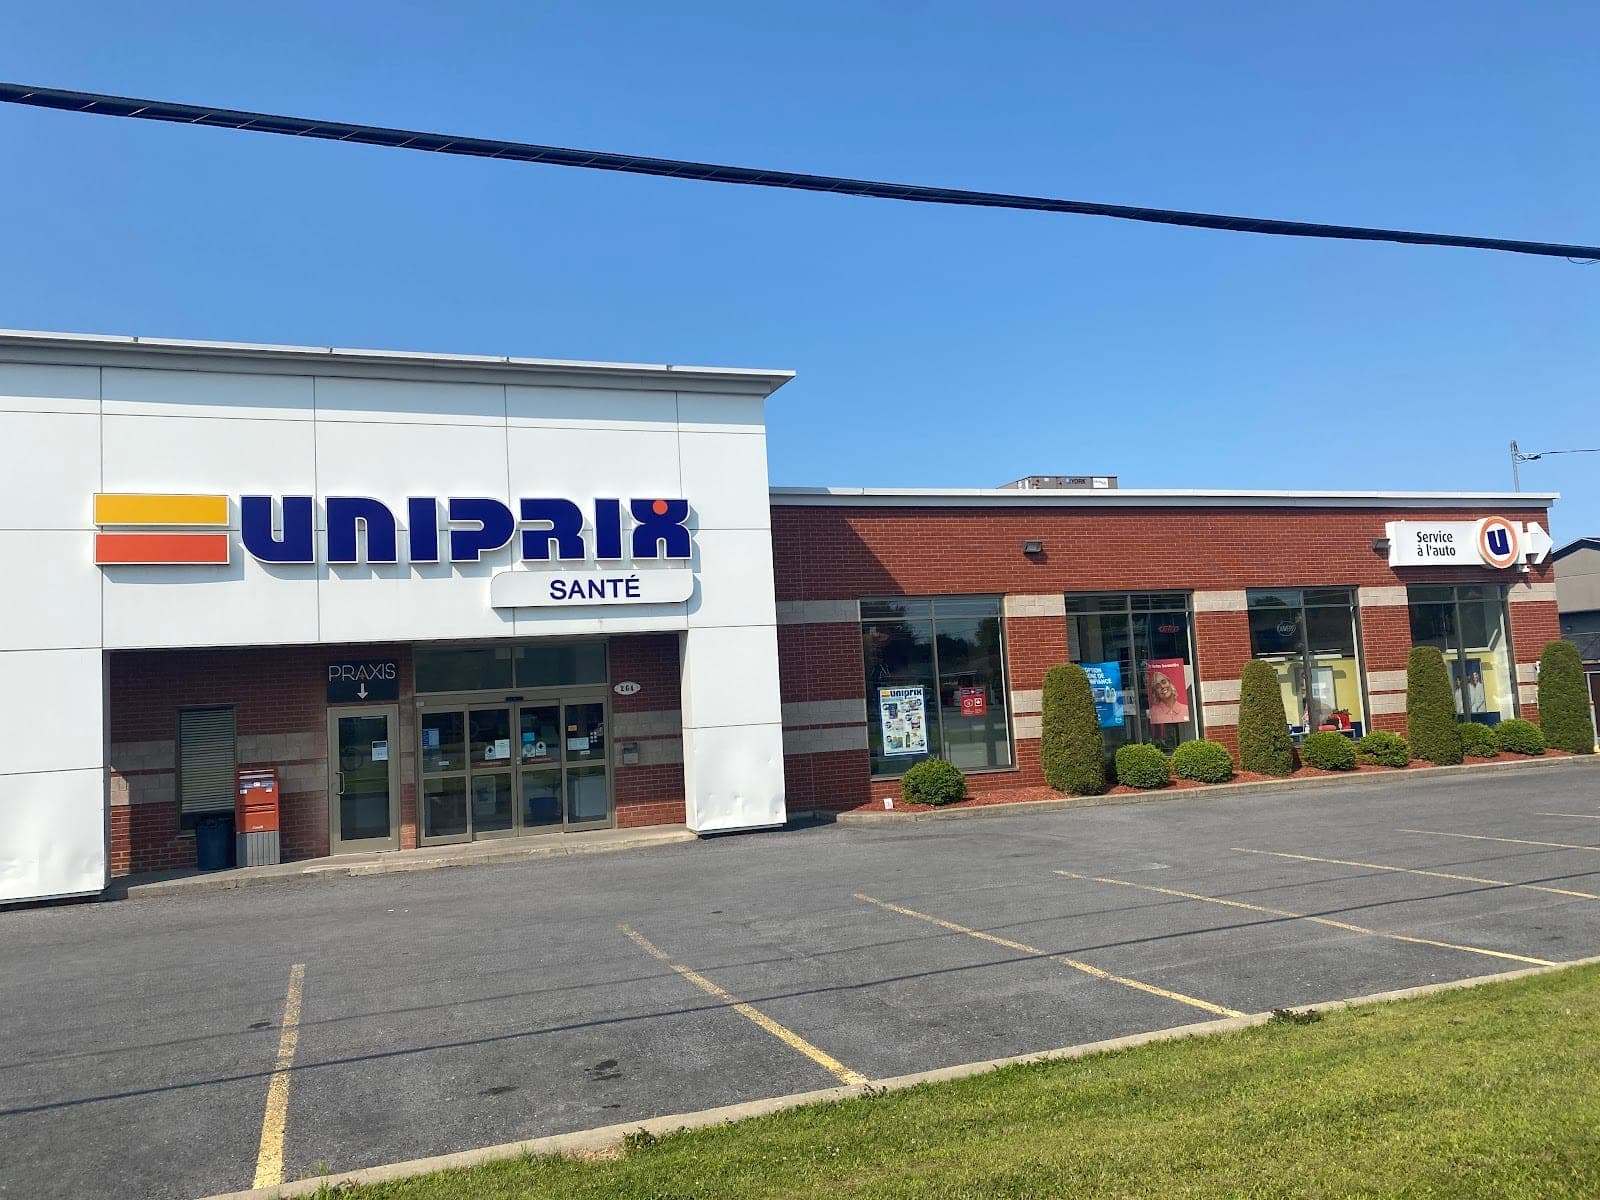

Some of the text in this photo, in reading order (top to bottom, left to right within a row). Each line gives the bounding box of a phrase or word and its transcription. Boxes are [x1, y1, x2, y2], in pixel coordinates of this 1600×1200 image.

[240, 495, 692, 564] UNIPRIX
[1416, 530, 1453, 543] Service
[1417, 543, 1456, 557] à l'auto
[549, 574, 641, 600] SANTÉ
[328, 662, 396, 682] PRAXIS
